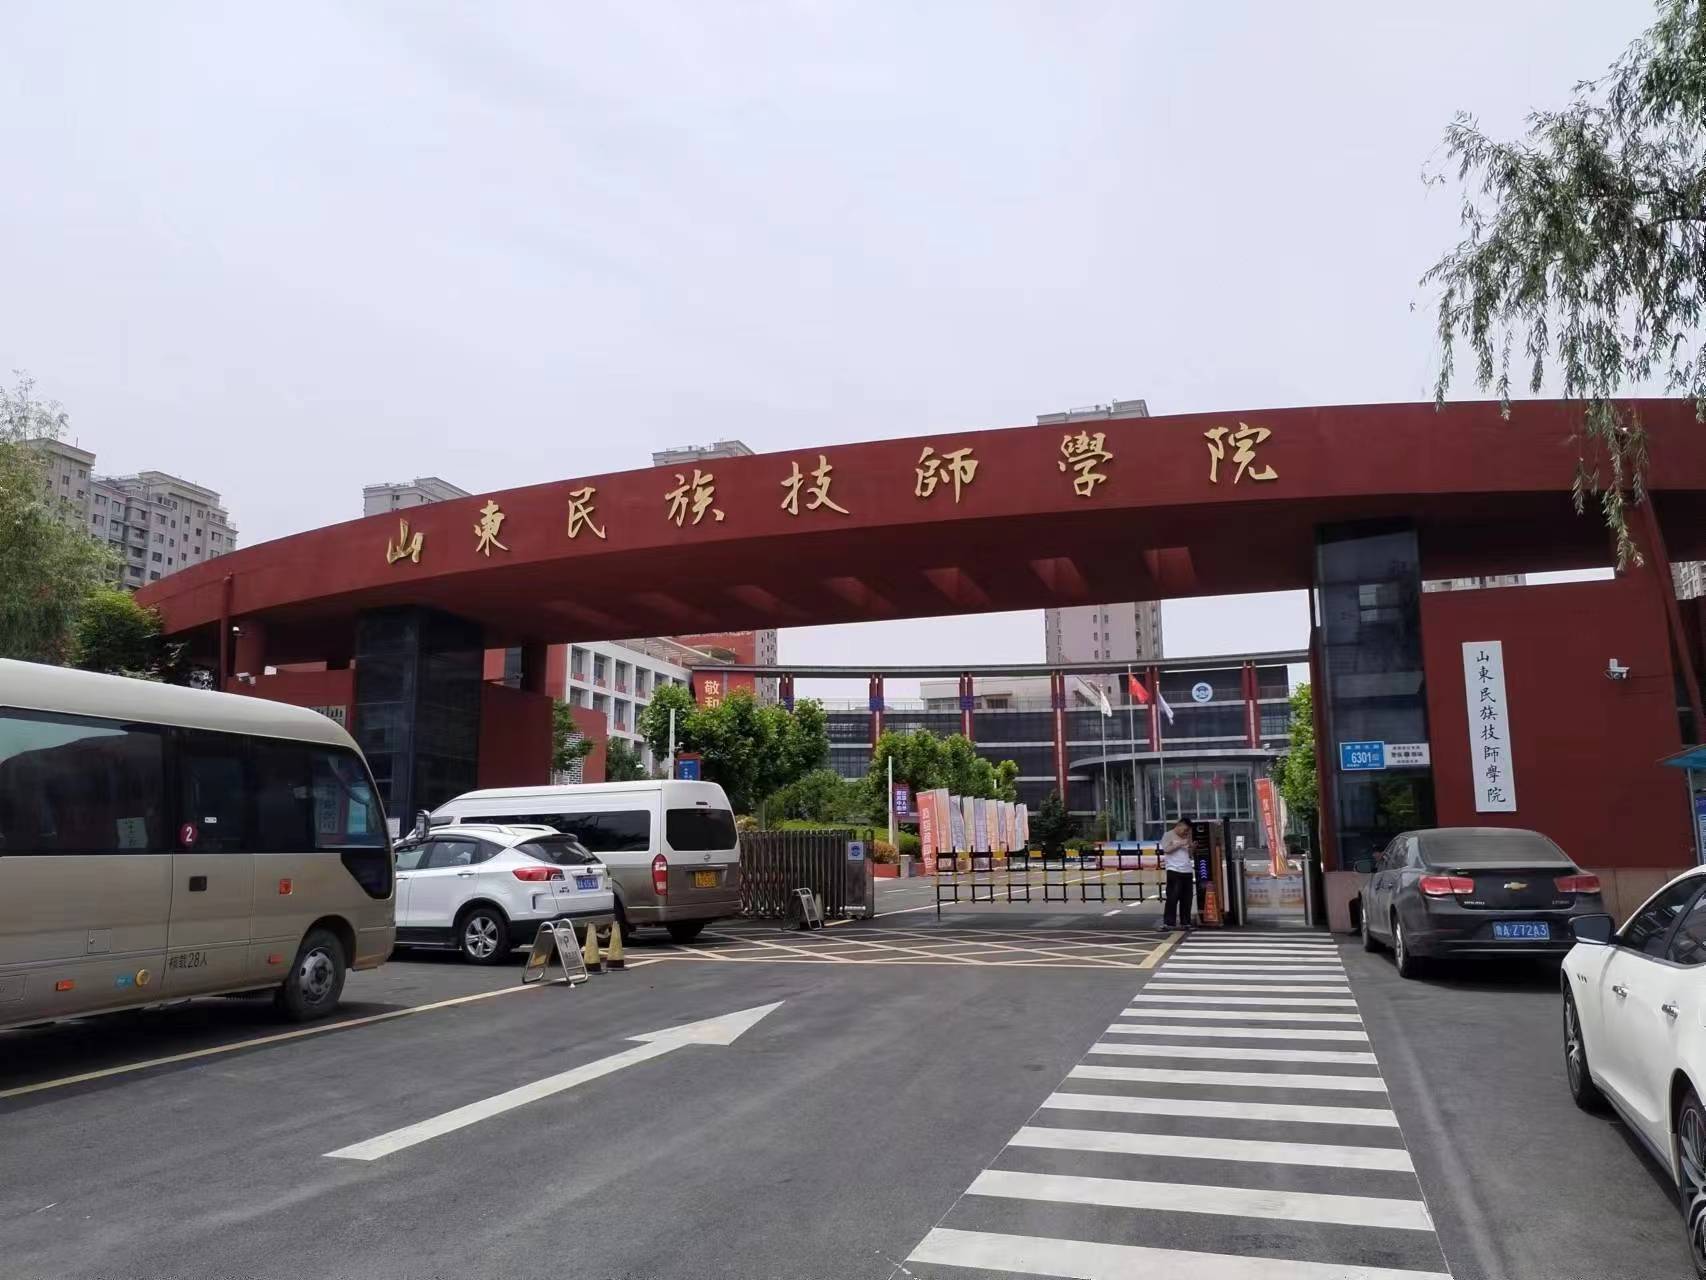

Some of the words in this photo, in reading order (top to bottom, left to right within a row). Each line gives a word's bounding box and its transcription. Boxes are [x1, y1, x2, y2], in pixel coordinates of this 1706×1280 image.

[387, 422, 1278, 565] 山東民族技師學院
[1476, 650, 1507, 803] 山東民族技師學院
[185, 826, 194, 842] 2
[168, 952, 208, 969] 核载28人
